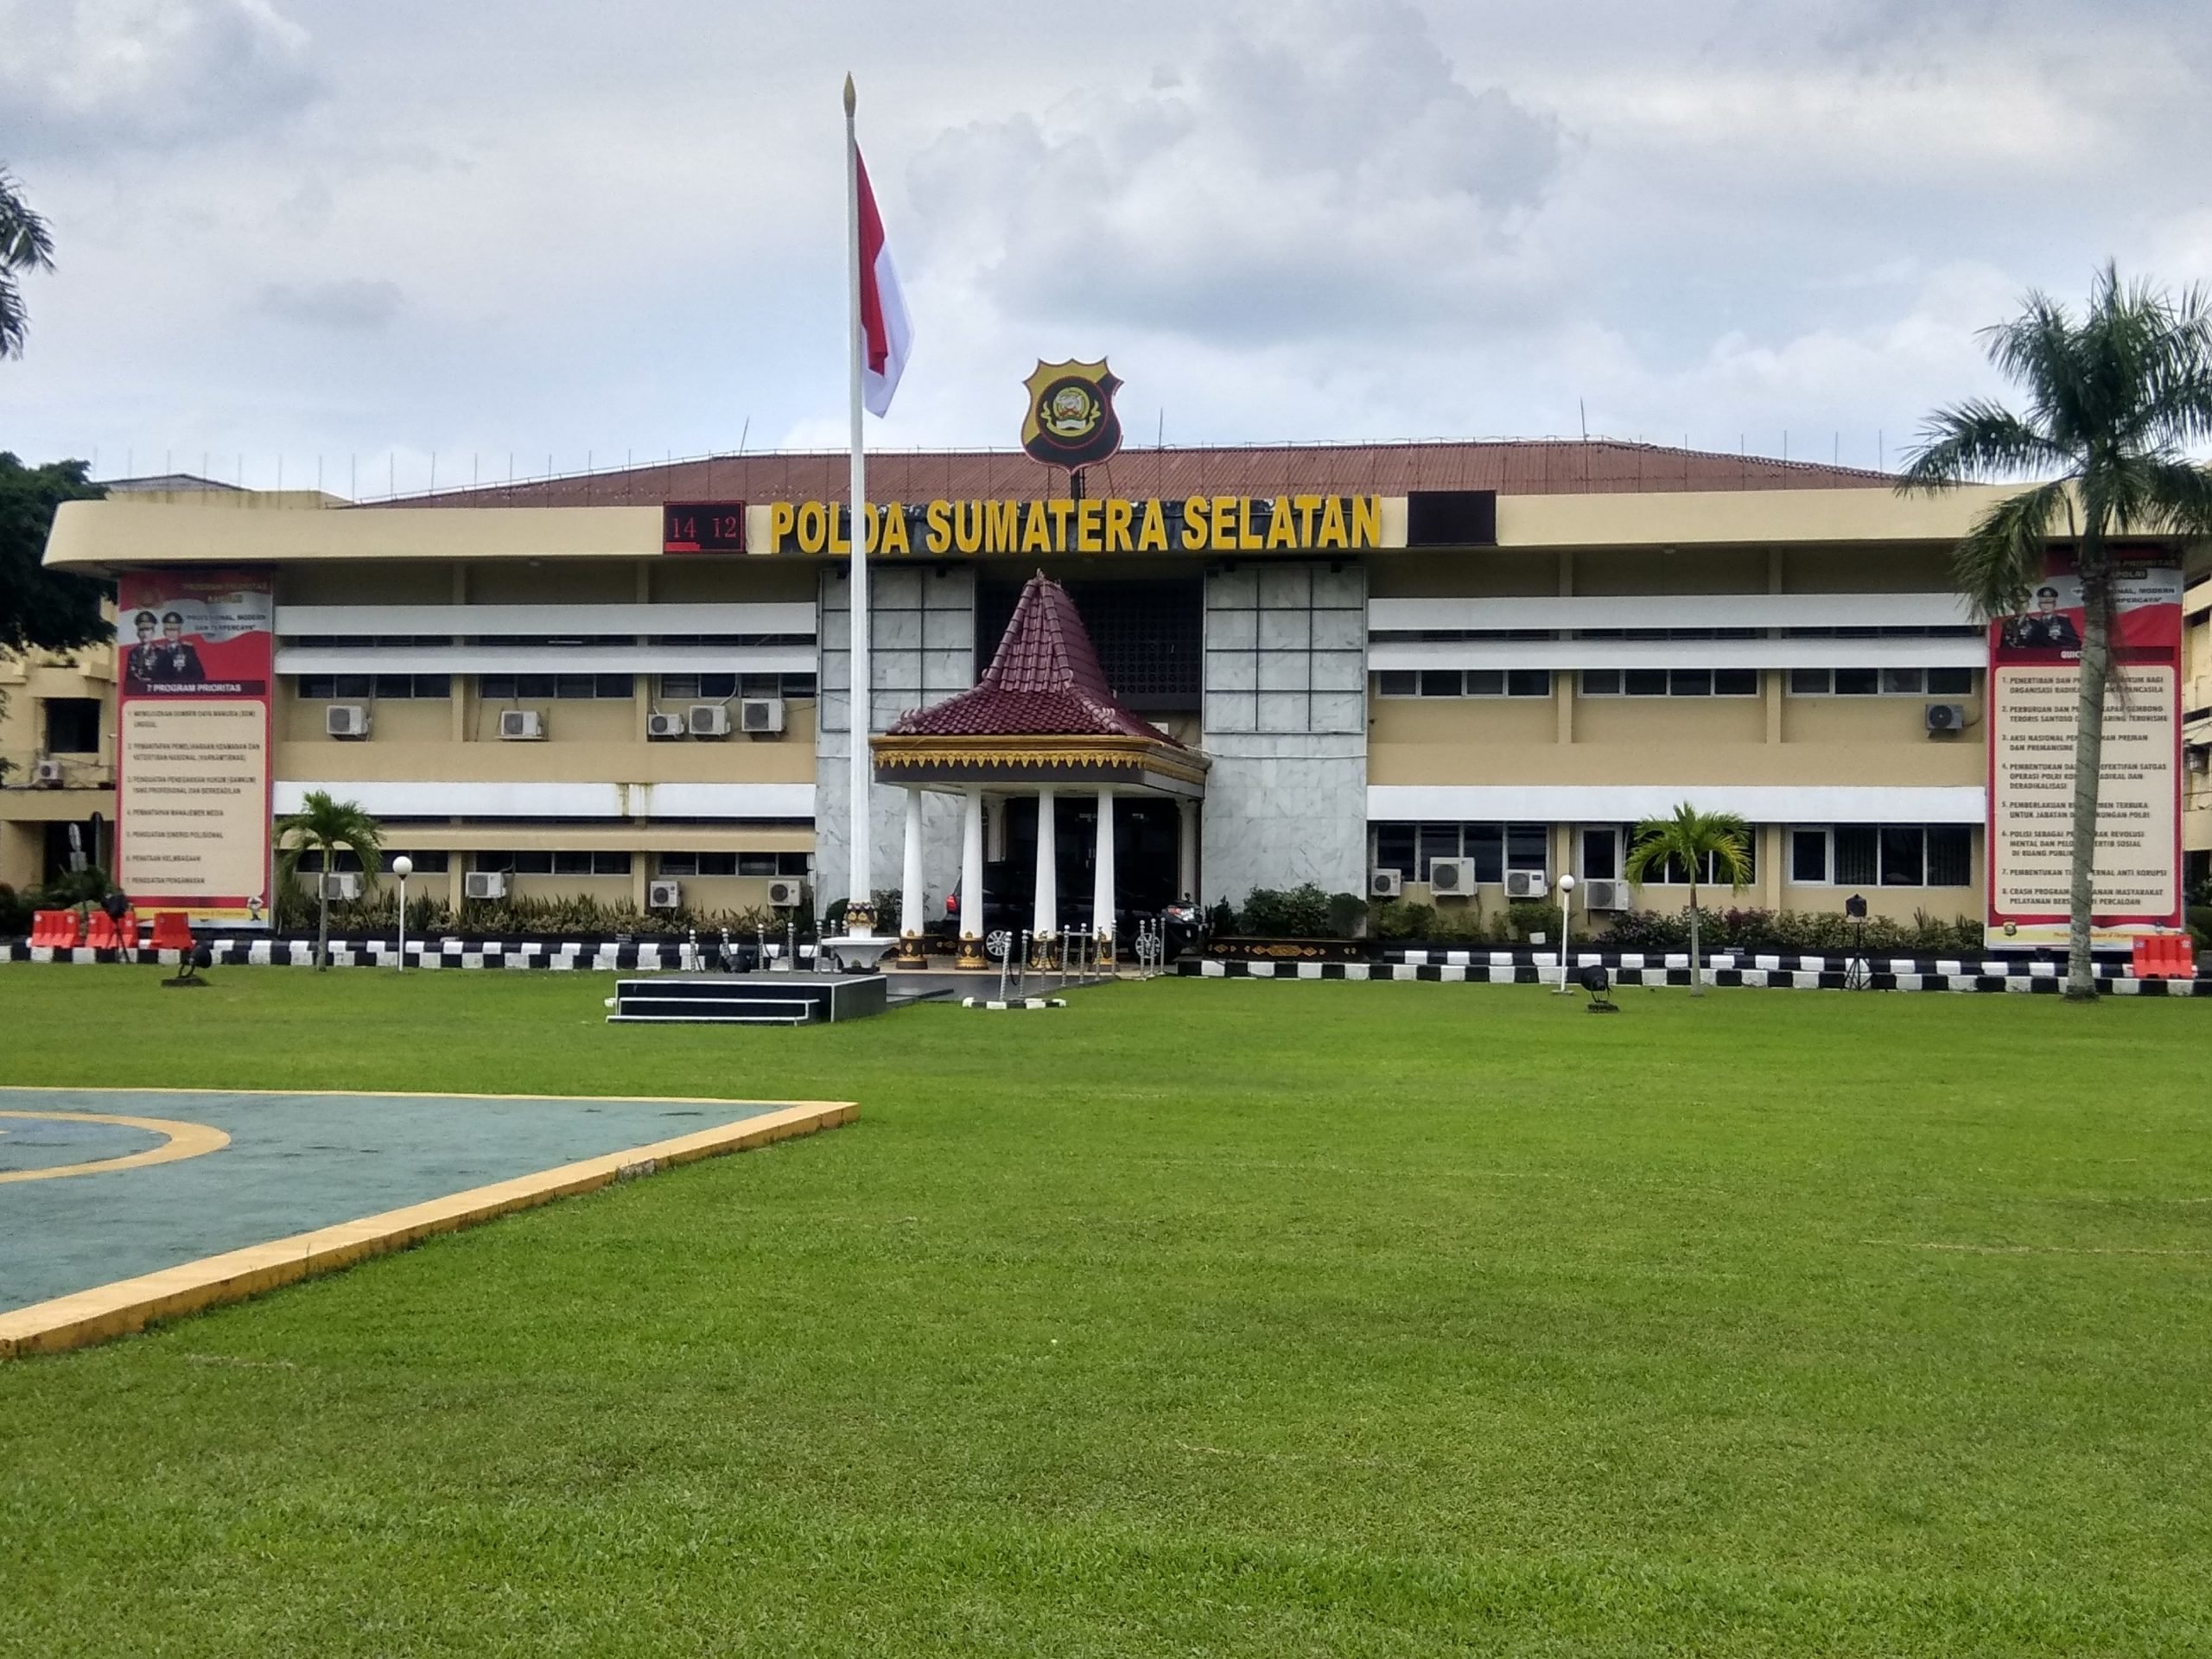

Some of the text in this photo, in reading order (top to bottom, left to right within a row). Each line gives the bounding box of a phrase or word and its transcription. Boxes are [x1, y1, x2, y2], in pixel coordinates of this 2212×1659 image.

[672, 517, 737, 538] 14 12
[771, 494, 1381, 554] POLDA SUMATERA SELATAN
[2061, 651, 2082, 659] QUIC
[153, 683, 196, 692] PROGRAM
[197, 683, 242, 692] PRIORITAS
